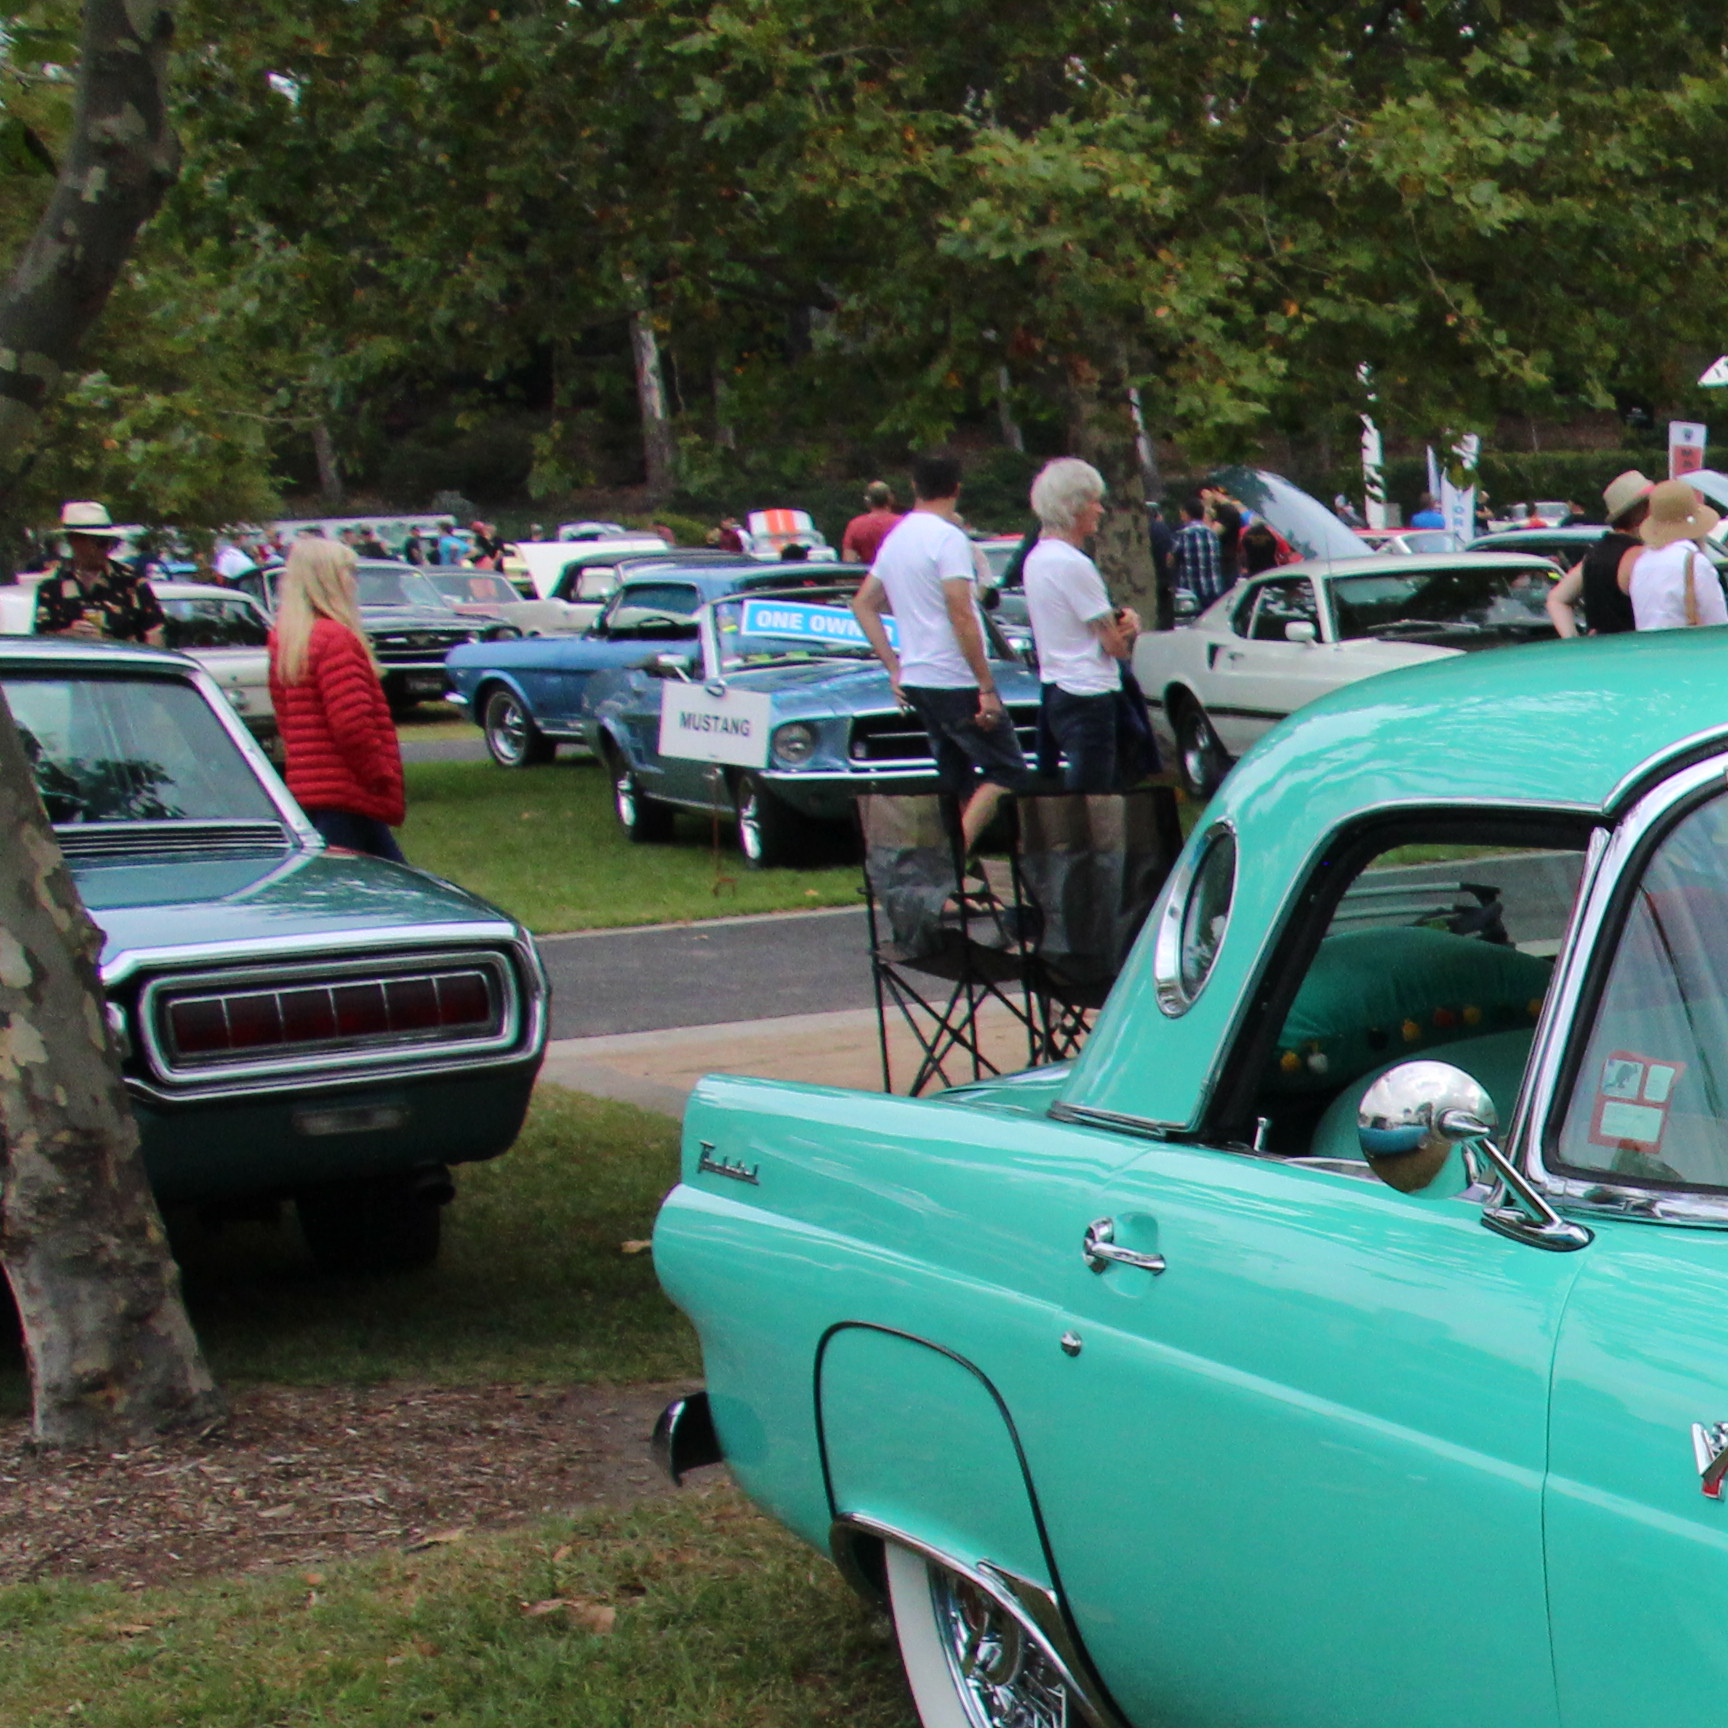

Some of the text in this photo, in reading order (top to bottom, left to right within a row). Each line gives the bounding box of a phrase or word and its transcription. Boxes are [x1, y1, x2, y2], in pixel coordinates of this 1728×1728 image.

[756, 610, 894, 641] ONE OWNR
[679, 711, 750, 737] MUSTANG
